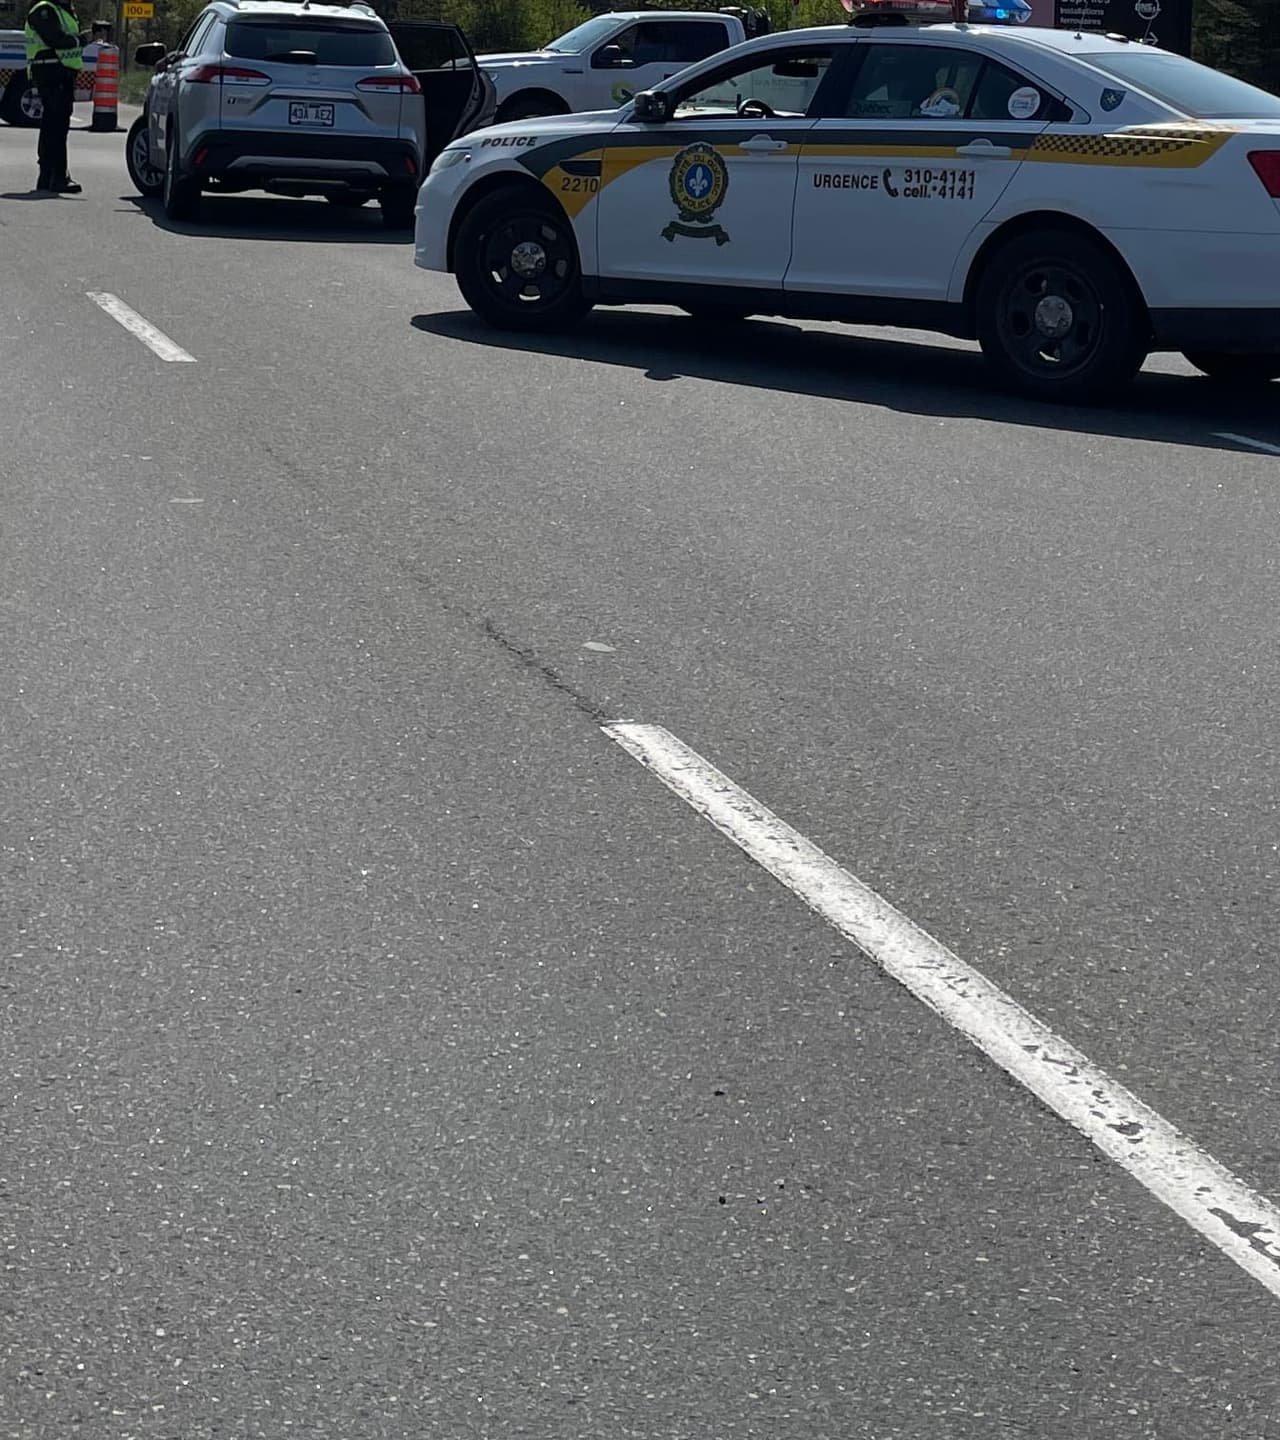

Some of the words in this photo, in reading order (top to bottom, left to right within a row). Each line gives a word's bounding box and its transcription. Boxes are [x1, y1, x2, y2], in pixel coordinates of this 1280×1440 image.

[481, 136, 538, 147] POLICE
[813, 174, 879, 189] URGENCE
[904, 169, 976, 185] 310-4141
[561, 177, 598, 193] 2210
